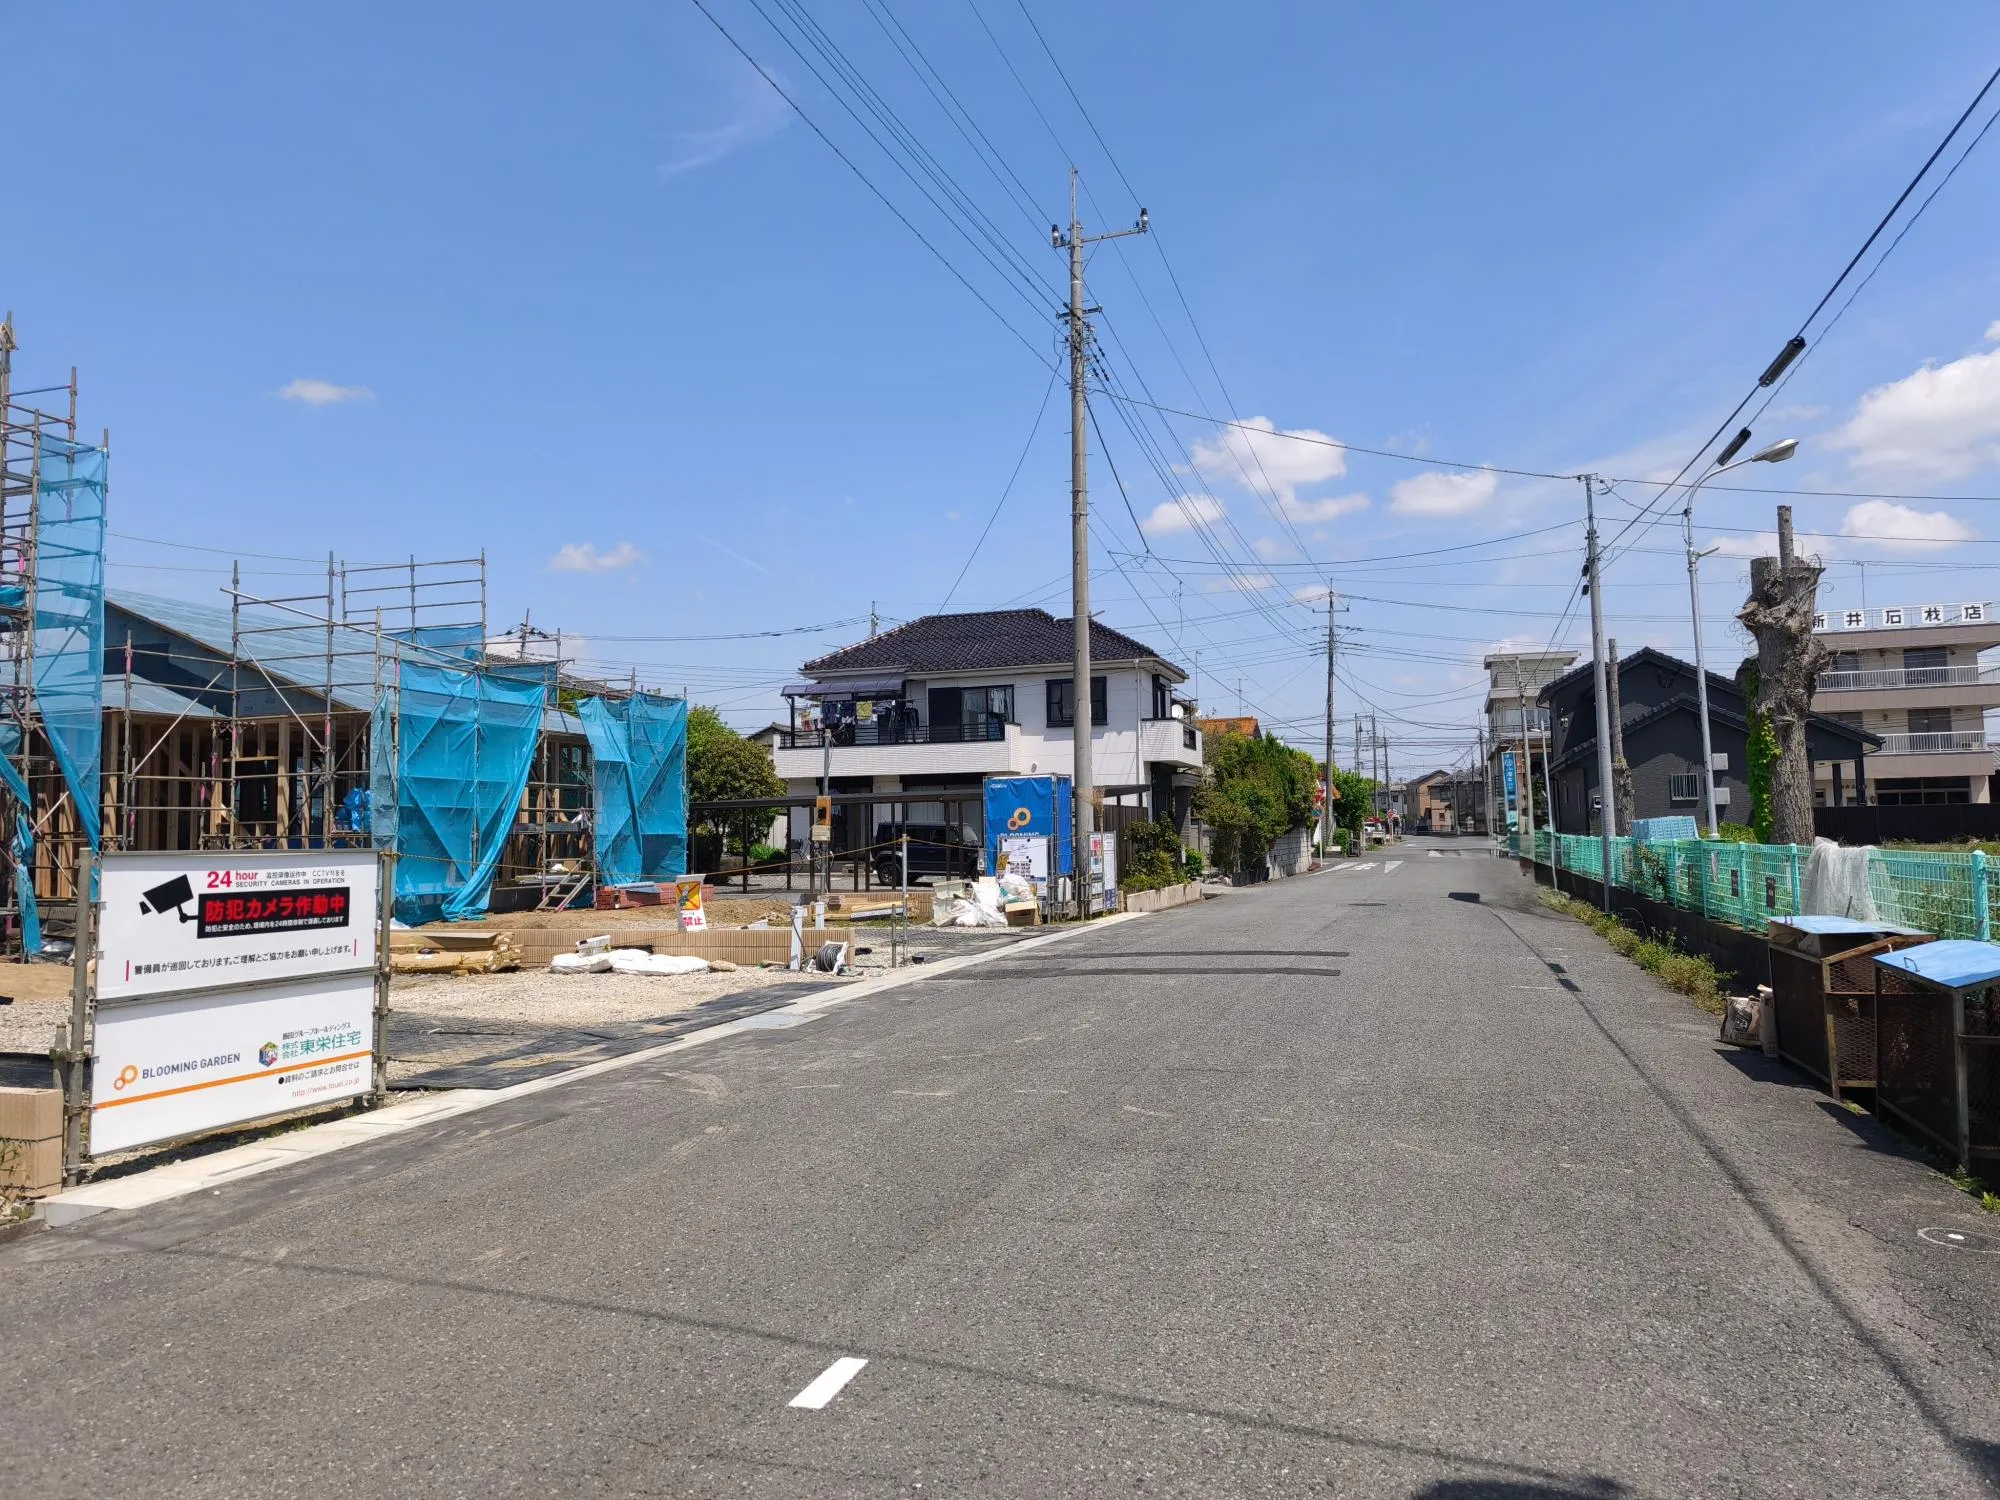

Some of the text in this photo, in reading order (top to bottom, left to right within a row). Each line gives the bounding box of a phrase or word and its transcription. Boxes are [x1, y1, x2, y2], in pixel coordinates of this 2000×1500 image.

[207, 871, 258, 888] 24 hour
[235, 880, 267, 888] SECURITY
[271, 879, 300, 887] CAMERAS
[312, 877, 345, 885] OPERATION
[205, 894, 345, 922] 防犯カメラ作動中
[300, 1031, 361, 1055] 東栄住宅
[142, 1053, 240, 1079] BLOOMING GARDEN
